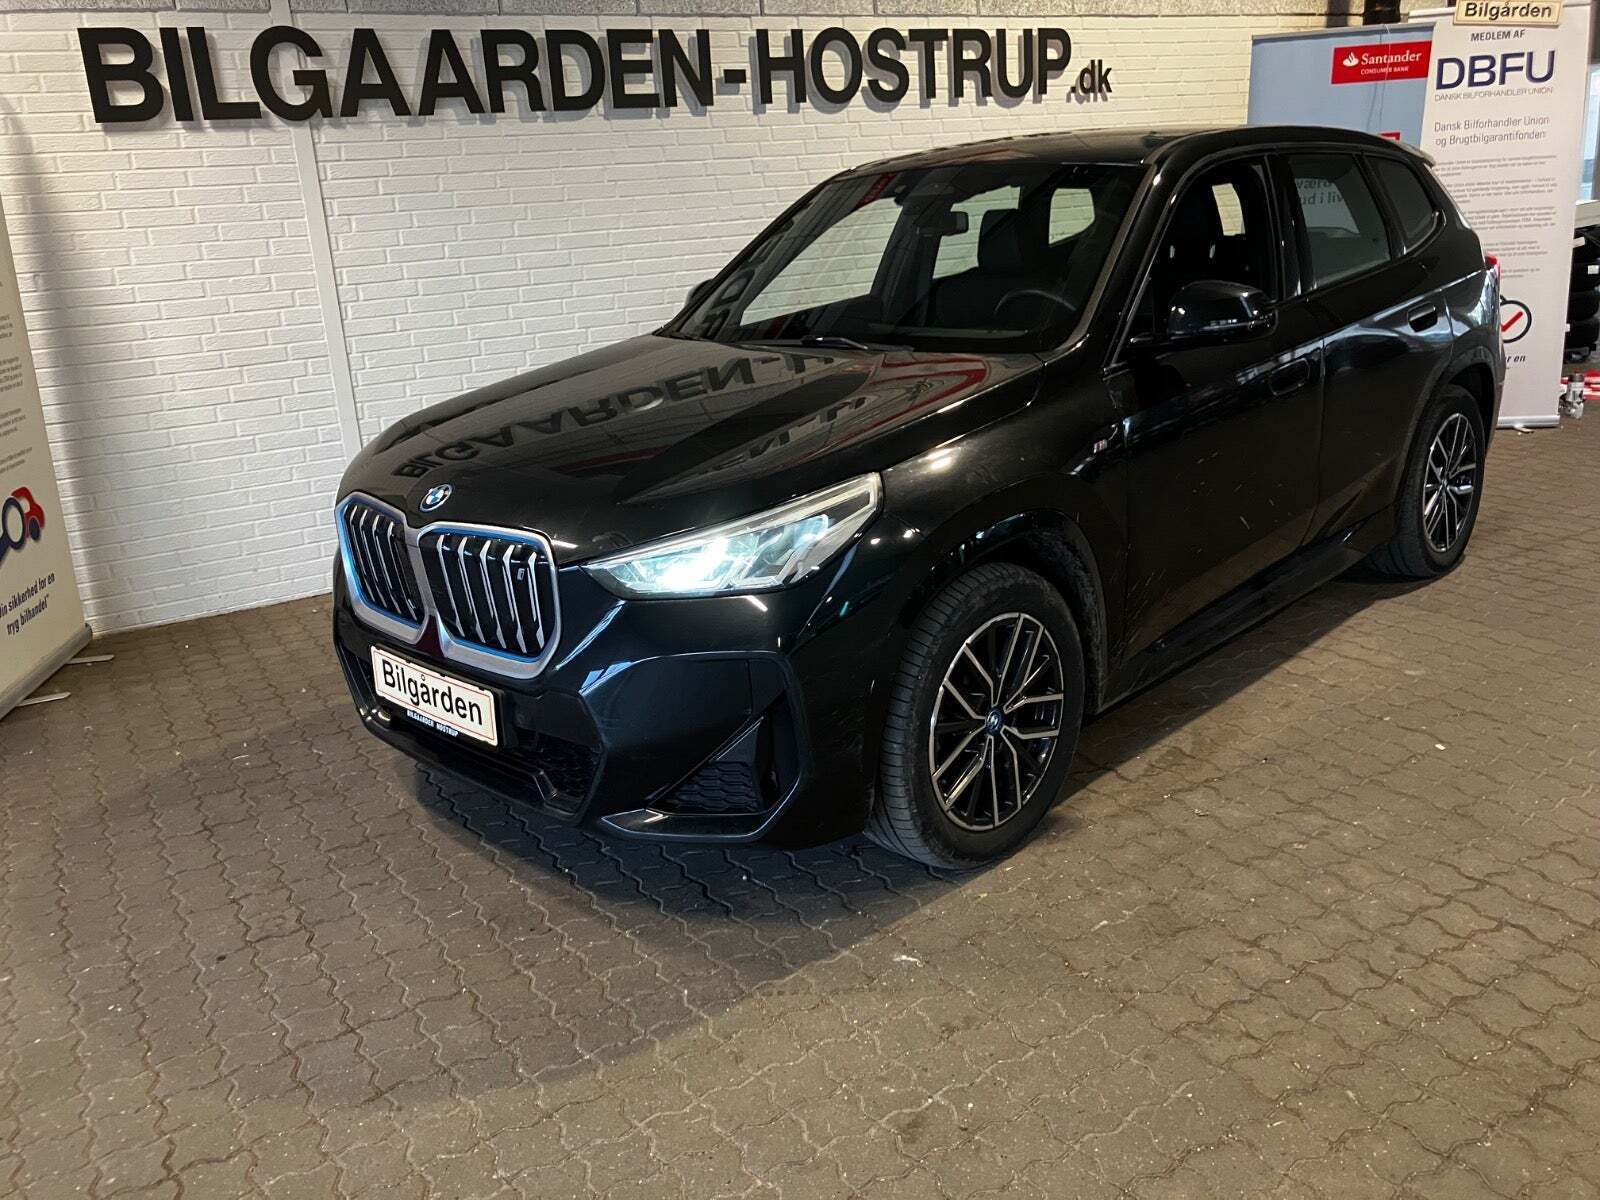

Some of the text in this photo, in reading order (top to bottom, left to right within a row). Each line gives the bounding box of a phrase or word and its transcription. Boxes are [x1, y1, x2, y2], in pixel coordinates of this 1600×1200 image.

[1464, 1, 1552, 20] Bilgården
[1470, 29, 1526, 42] MEDLEM AF
[1361, 52, 1422, 66] Santander
[1360, 67, 1392, 75] CONSUMER
[1436, 50, 1555, 90] DBFU
[1434, 86, 1554, 102] DANSK BILFORHANDLER UNION
[1434, 116, 1550, 132] Dansk Bilforhandler Union
[1435, 137, 1447, 148] og
[8, 580, 38, 612] sikkerhed
[38, 577, 47, 591] for
[47, 572, 56, 585] en
[7, 618, 20, 636] tryg
[382, 658, 483, 726] Bilgården
